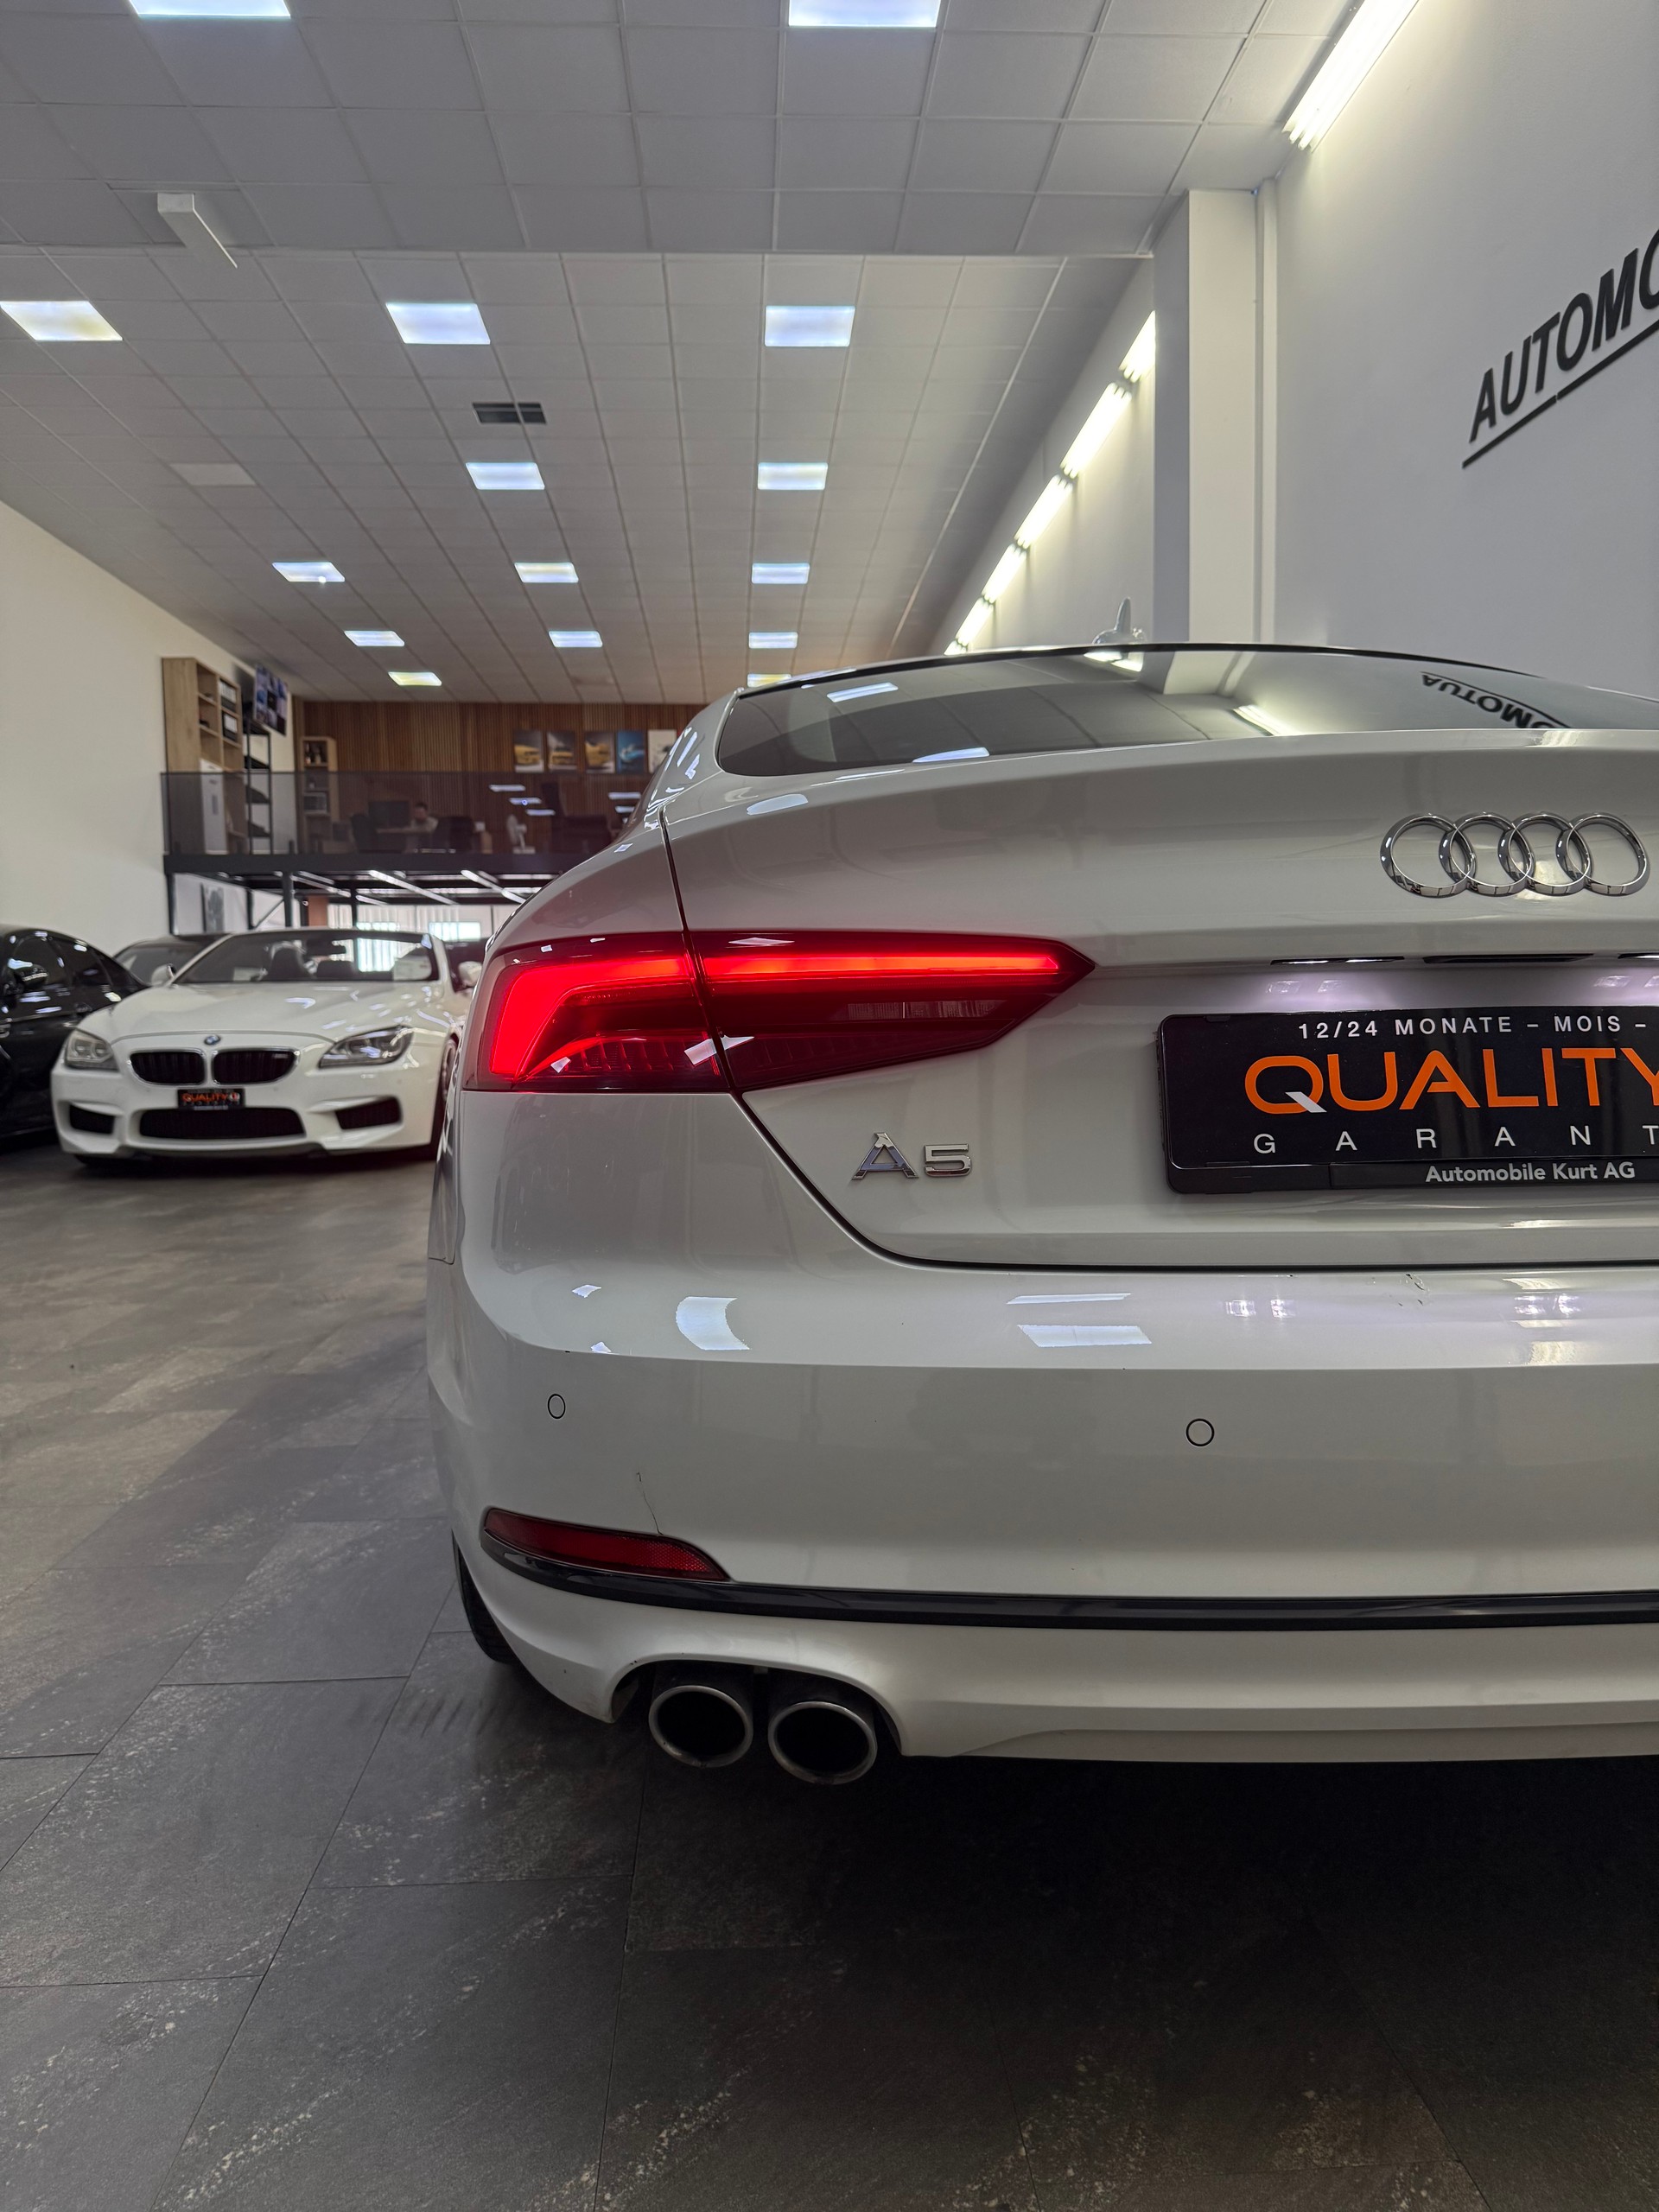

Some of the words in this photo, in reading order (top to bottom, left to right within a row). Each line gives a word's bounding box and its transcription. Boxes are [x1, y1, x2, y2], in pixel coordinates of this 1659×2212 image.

[1299, 1020, 1378, 1039] 12/24
[1395, 1016, 1512, 1036] MONATE
[1554, 1014, 1621, 1033] MOIS
[851, 1132, 972, 1179] A5
[1425, 1163, 1546, 1183] Automobile
[1553, 1162, 1598, 1180] Kurt
[1604, 1161, 1636, 1179] AG
